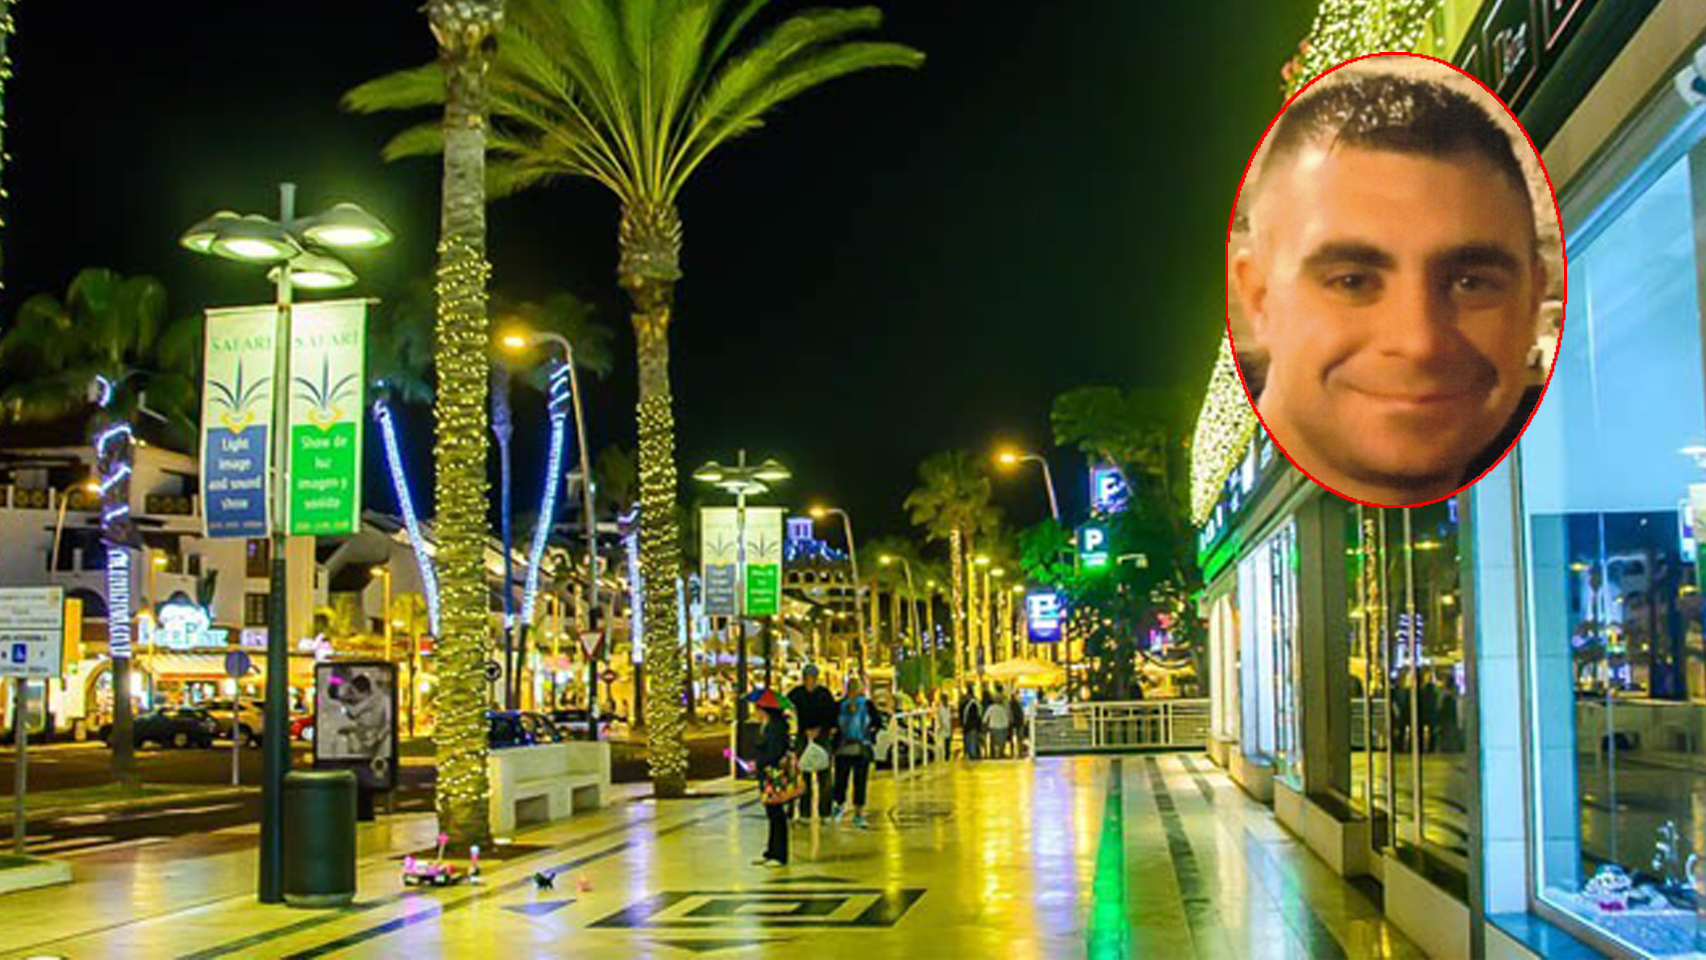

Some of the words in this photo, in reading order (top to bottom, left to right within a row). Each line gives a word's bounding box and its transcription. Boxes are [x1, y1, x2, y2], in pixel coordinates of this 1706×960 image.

[221, 437, 249, 452] Light
[301, 436, 330, 449] Show
[218, 458, 251, 472] image
[208, 477, 228, 490] and
[231, 475, 261, 490] sound
[298, 478, 339, 491] imagen
[221, 498, 248, 510] show
[1084, 528, 1103, 551] P
